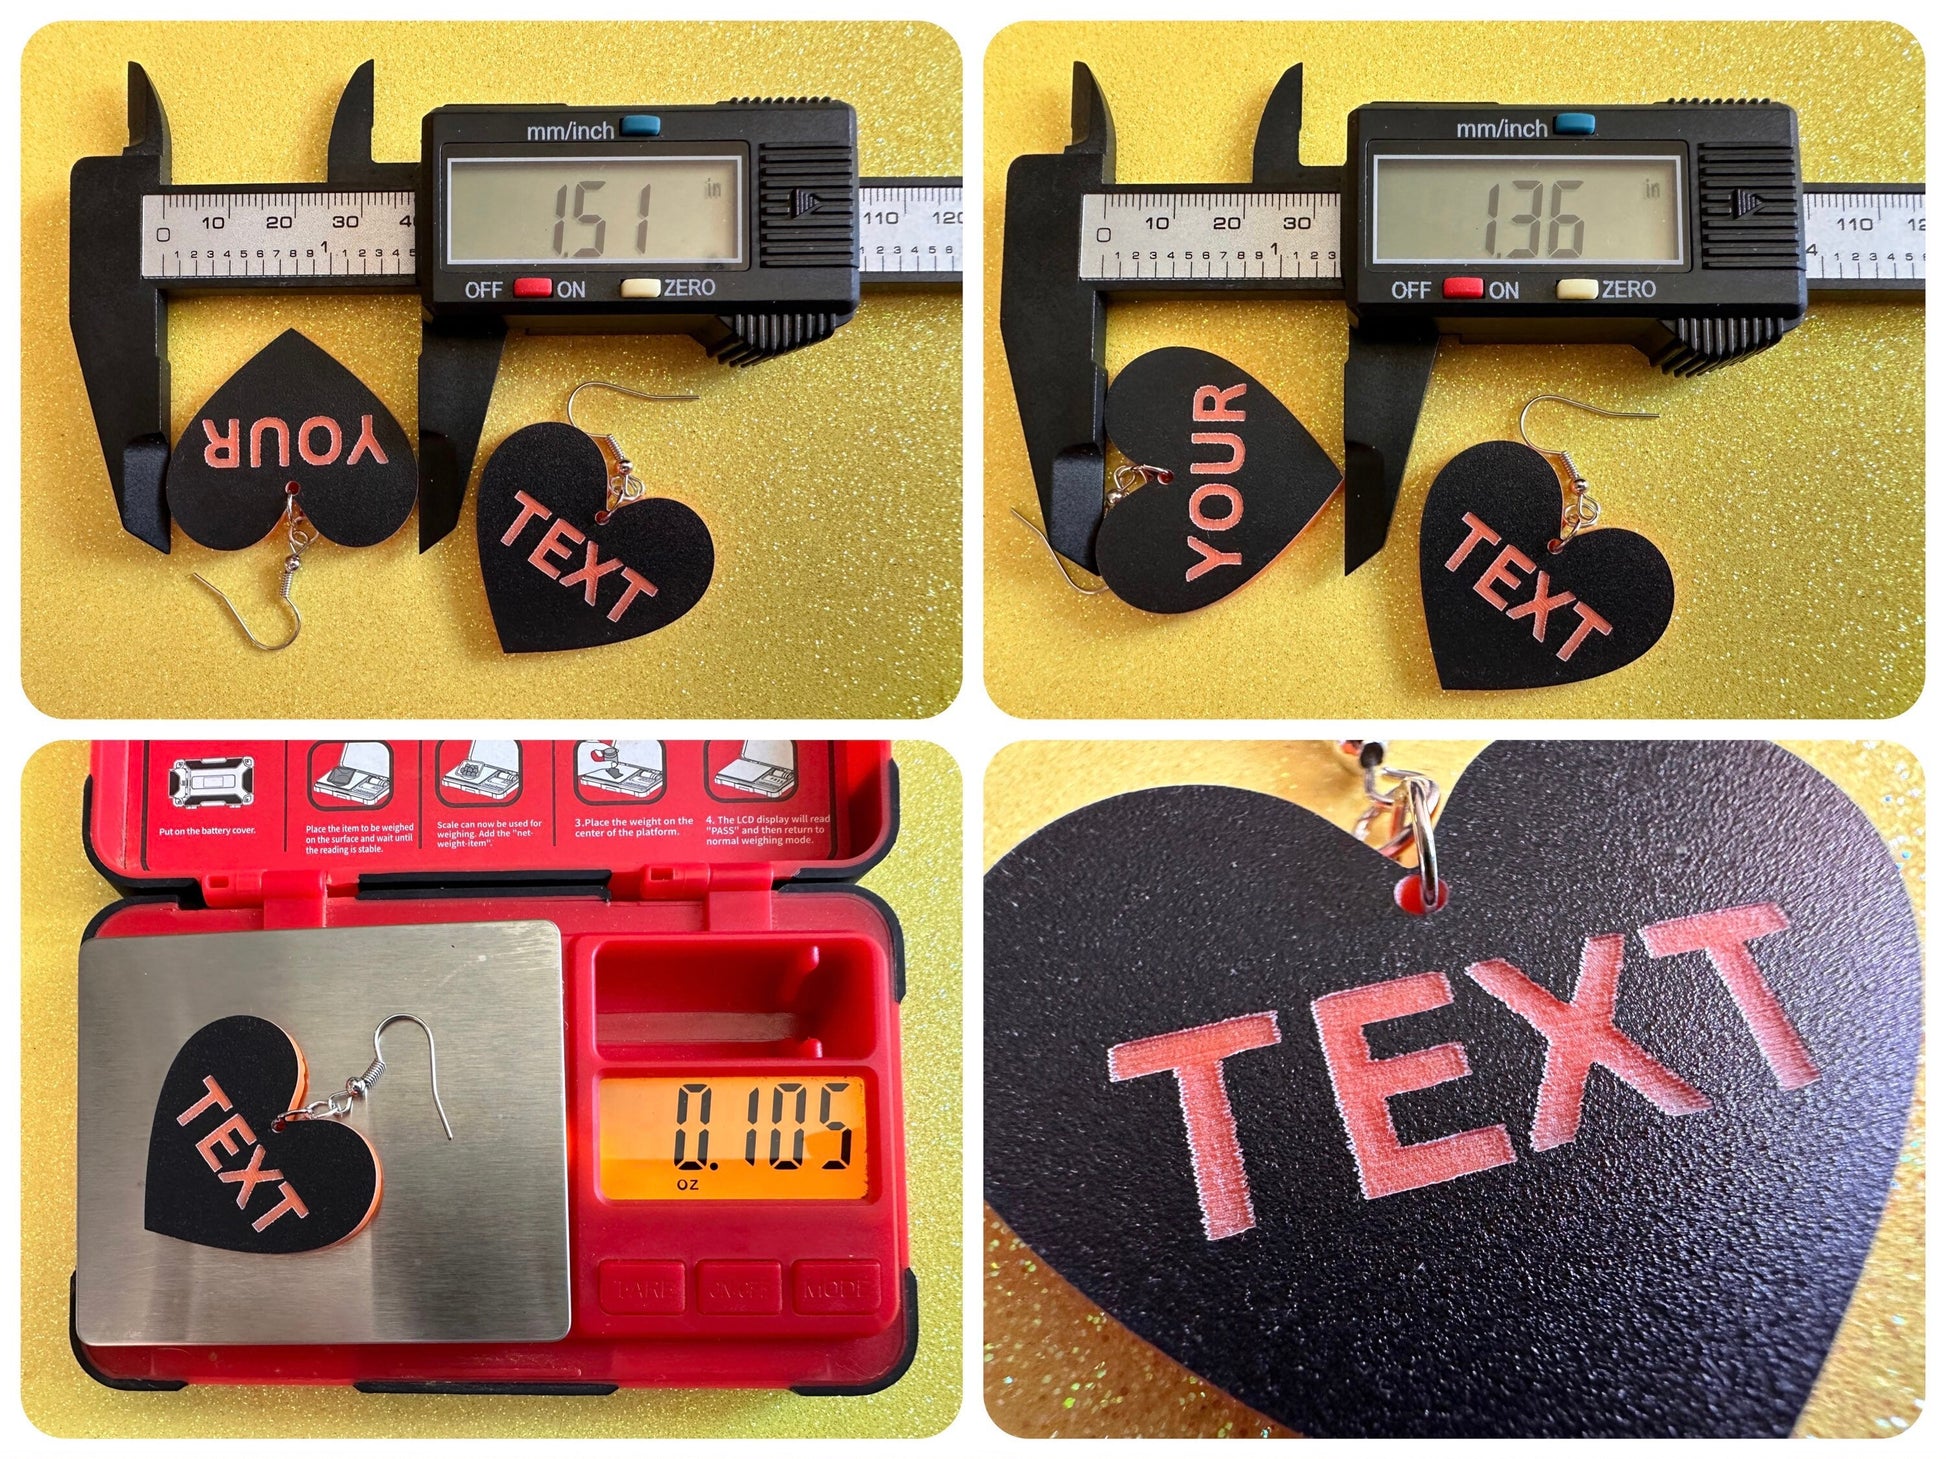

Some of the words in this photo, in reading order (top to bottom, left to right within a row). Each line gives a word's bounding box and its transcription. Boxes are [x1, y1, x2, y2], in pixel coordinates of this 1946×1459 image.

[527, 121, 615, 142] mm/inch
[1457, 119, 1548, 139] mm/inch
[705, 178, 721, 198] in
[1644, 179, 1660, 199] in
[202, 217, 225, 229] 10
[266, 216, 292, 229] 20
[332, 216, 358, 228] 30
[399, 215, 415, 227] 4
[553, 181, 651, 258] 1.51
[863, 212, 899, 225] 110
[1145, 217, 1169, 230] 10
[1213, 217, 1240, 230] 20
[1283, 217, 1311, 230] 30
[1485, 180, 1584, 259] 1.36
[1837, 218, 1873, 231] 110
[320, 241, 328, 253] 1
[1270, 243, 1278, 255] 1
[1806, 243, 1818, 256] 4
[465, 281, 503, 299] OFF
[557, 281, 586, 299] ON
[664, 278, 716, 297] ZERO
[1391, 281, 1432, 300] OFF
[1489, 281, 1519, 299] ON
[1602, 280, 1657, 298] ZERO
[203, 414, 389, 469] YOUR
[1185, 382, 1247, 582] YOUR
[500, 489, 658, 623] TEXT
[1443, 511, 1612, 662] TEXT
[306, 825, 326, 833] Place
[328, 825, 340, 833] the
[342, 824, 359, 833] item
[370, 824, 380, 832] be
[382, 823, 414, 833] weighed
[437, 821, 459, 829] Scale
[496, 820, 506, 828] be
[508, 820, 528, 828] used
[530, 819, 542, 827] for
[612, 818, 627, 826] the
[630, 817, 661, 827] weight
[678, 816, 694, 825] the
[706, 816, 715, 824] 4.
[718, 816, 735, 824] The
[737, 816, 754, 824] LCD
[757, 815, 790, 825] display
[159, 828, 173, 836] Put
[201, 827, 231, 836] battery
[331, 835, 359, 843] surface
[360, 834, 375, 843] and
[377, 834, 393, 842] wait
[395, 834, 413, 842] until
[618, 828, 634, 836] the
[636, 828, 680, 838] platform.
[706, 826, 739, 834] "PASS"
[742, 826, 759, 834] and
[761, 826, 782, 834] then
[785, 826, 813, 834] return
[706, 837, 739, 845] normal
[741, 836, 783, 846] weighing
[785, 836, 814, 844] mode.
[306, 846, 318, 854] the
[320, 845, 349, 856] reading
[351, 845, 357, 853] is
[358, 845, 383, 853] stable.
[1109, 902, 1820, 1240] TEXT
[674, 1083, 852, 1171] 0.105
[176, 1075, 309, 1233] TEXT
